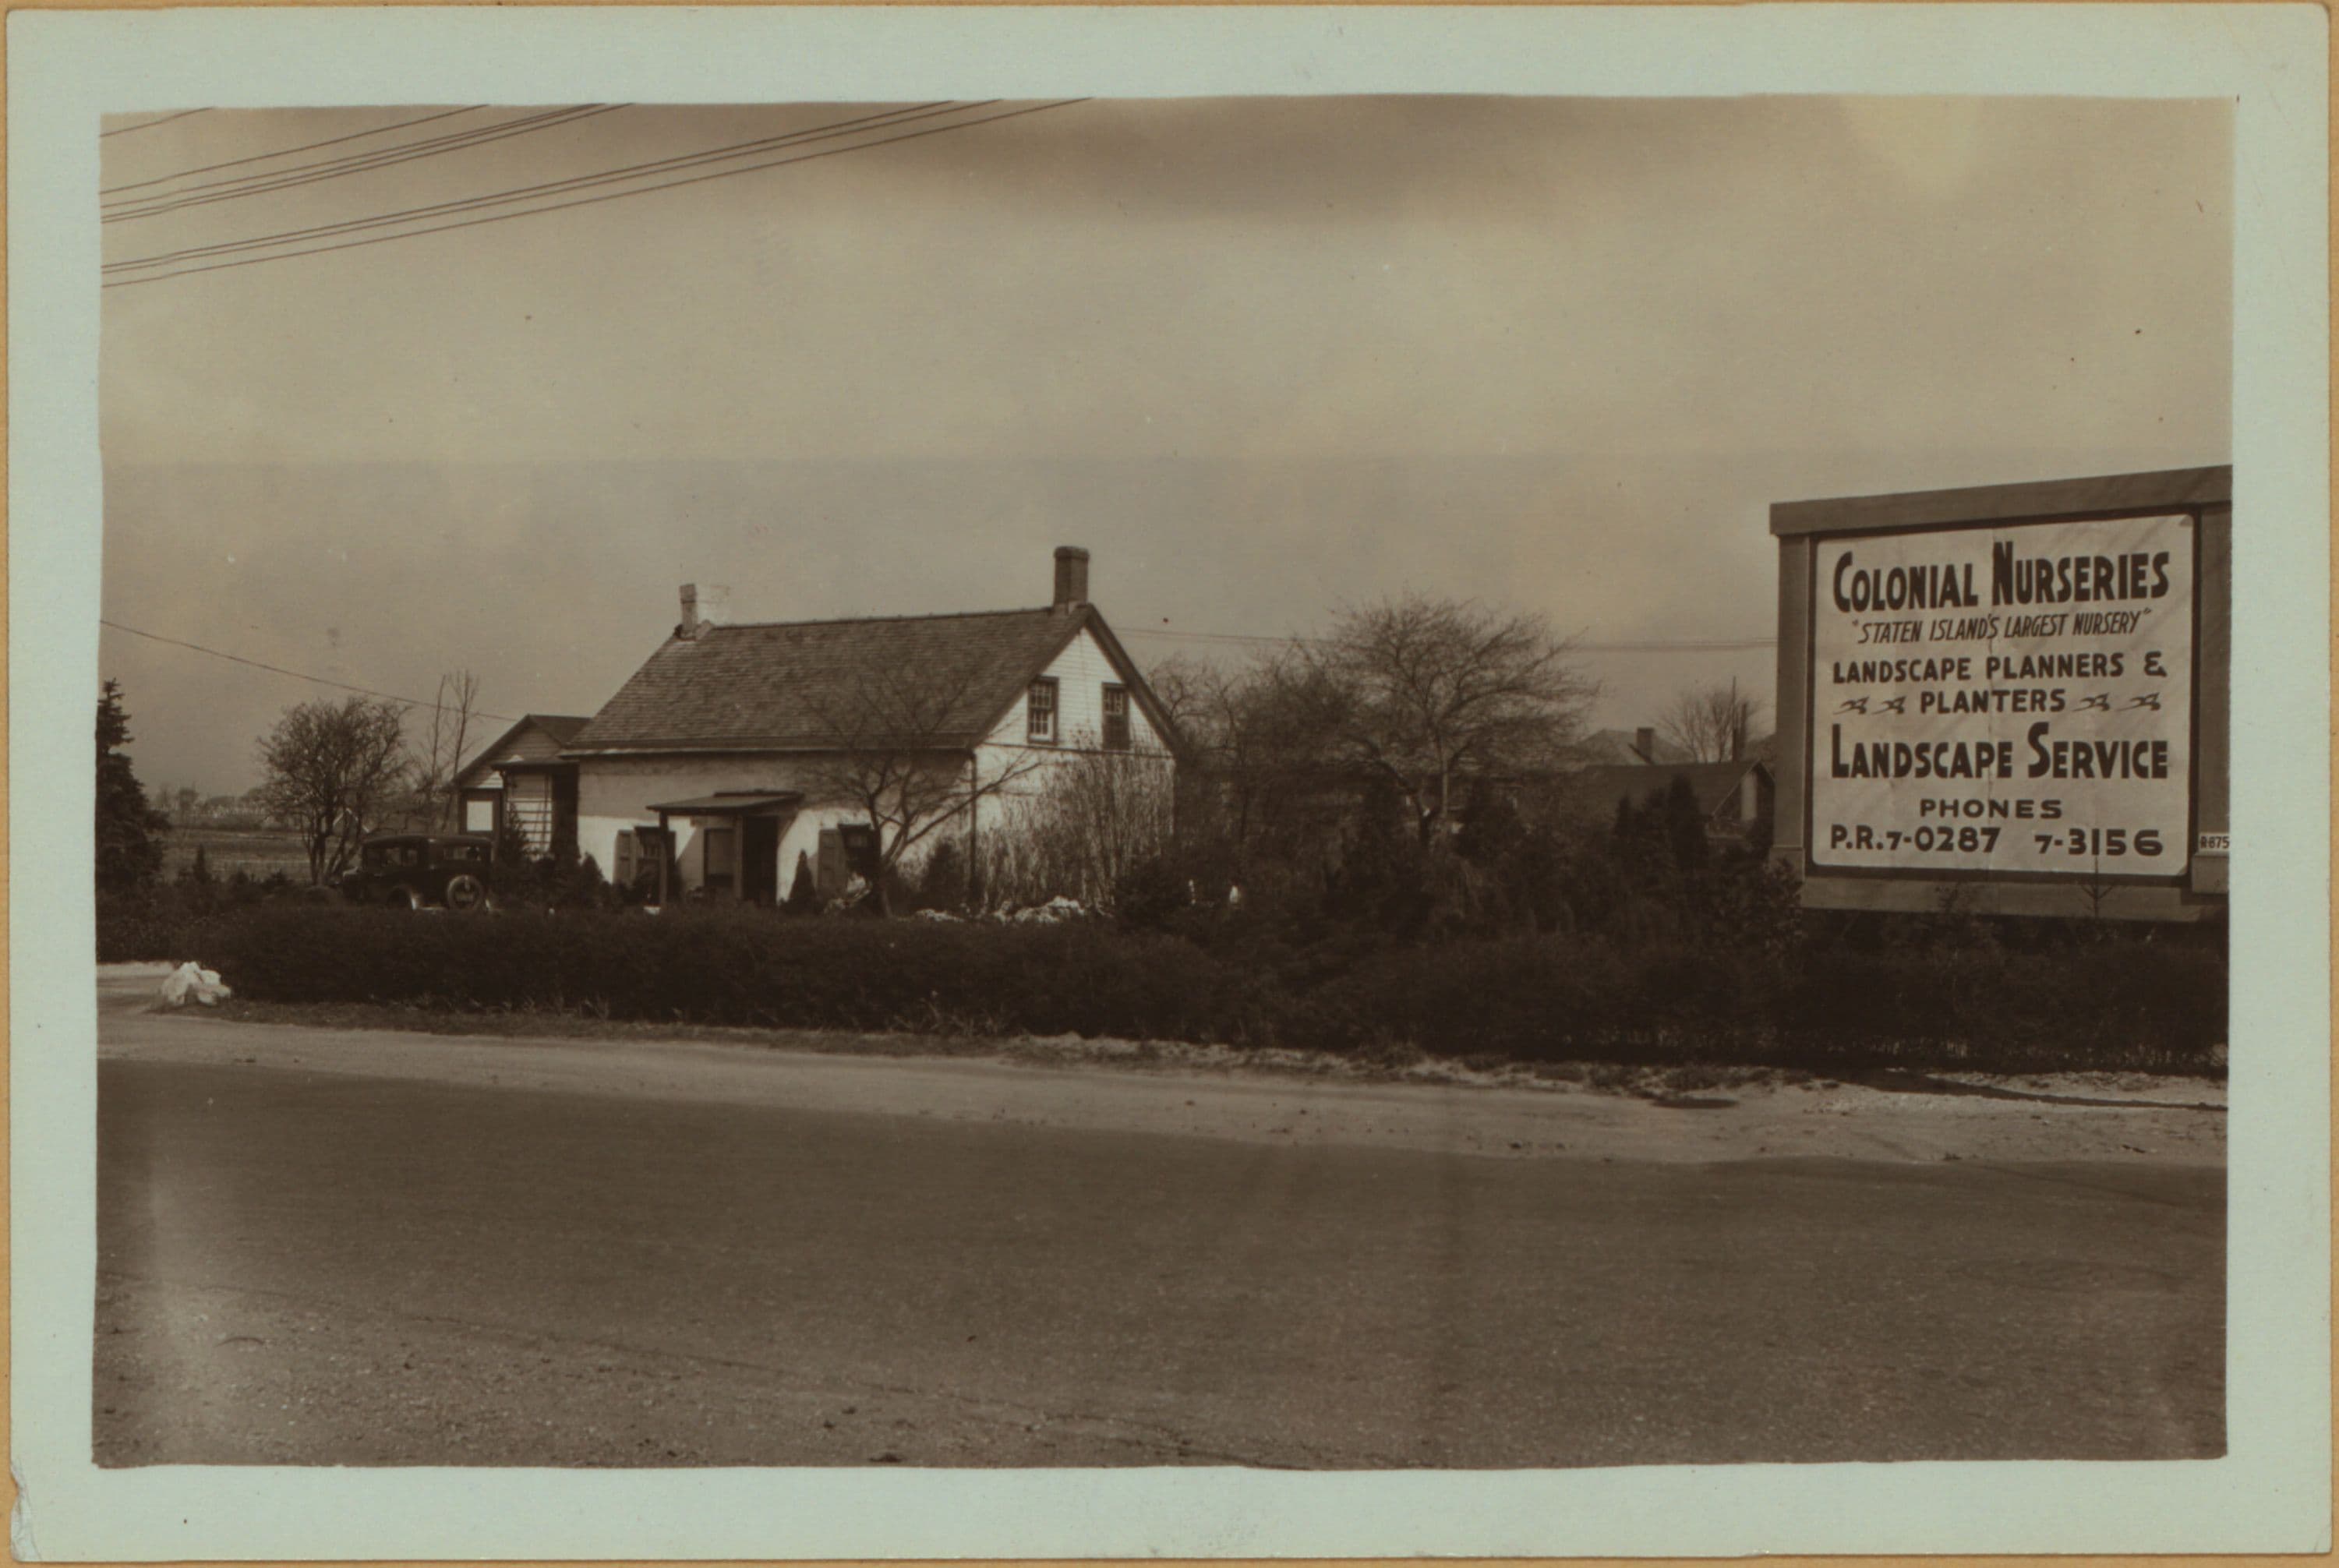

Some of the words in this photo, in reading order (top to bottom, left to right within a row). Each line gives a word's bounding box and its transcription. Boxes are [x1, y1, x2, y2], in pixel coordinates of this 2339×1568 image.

[1833, 551, 1978, 613] COLONIAL
[1992, 542, 2169, 606] NURSERIES
[1929, 613, 1998, 641] ISLAND'S
[2004, 613, 2069, 637] LARGEST
[1833, 658, 1971, 683] LANDSCAPE
[1986, 652, 2125, 680] PLANNERS
[2144, 651, 2168, 677] &
[1920, 688, 2065, 714] PLANTERS
[1832, 723, 2012, 779] LANDSCAPE
[2027, 722, 2168, 779] SERVICE
[1920, 799, 2063, 819] PHONES
[2034, 828, 2164, 856] 7-3156
